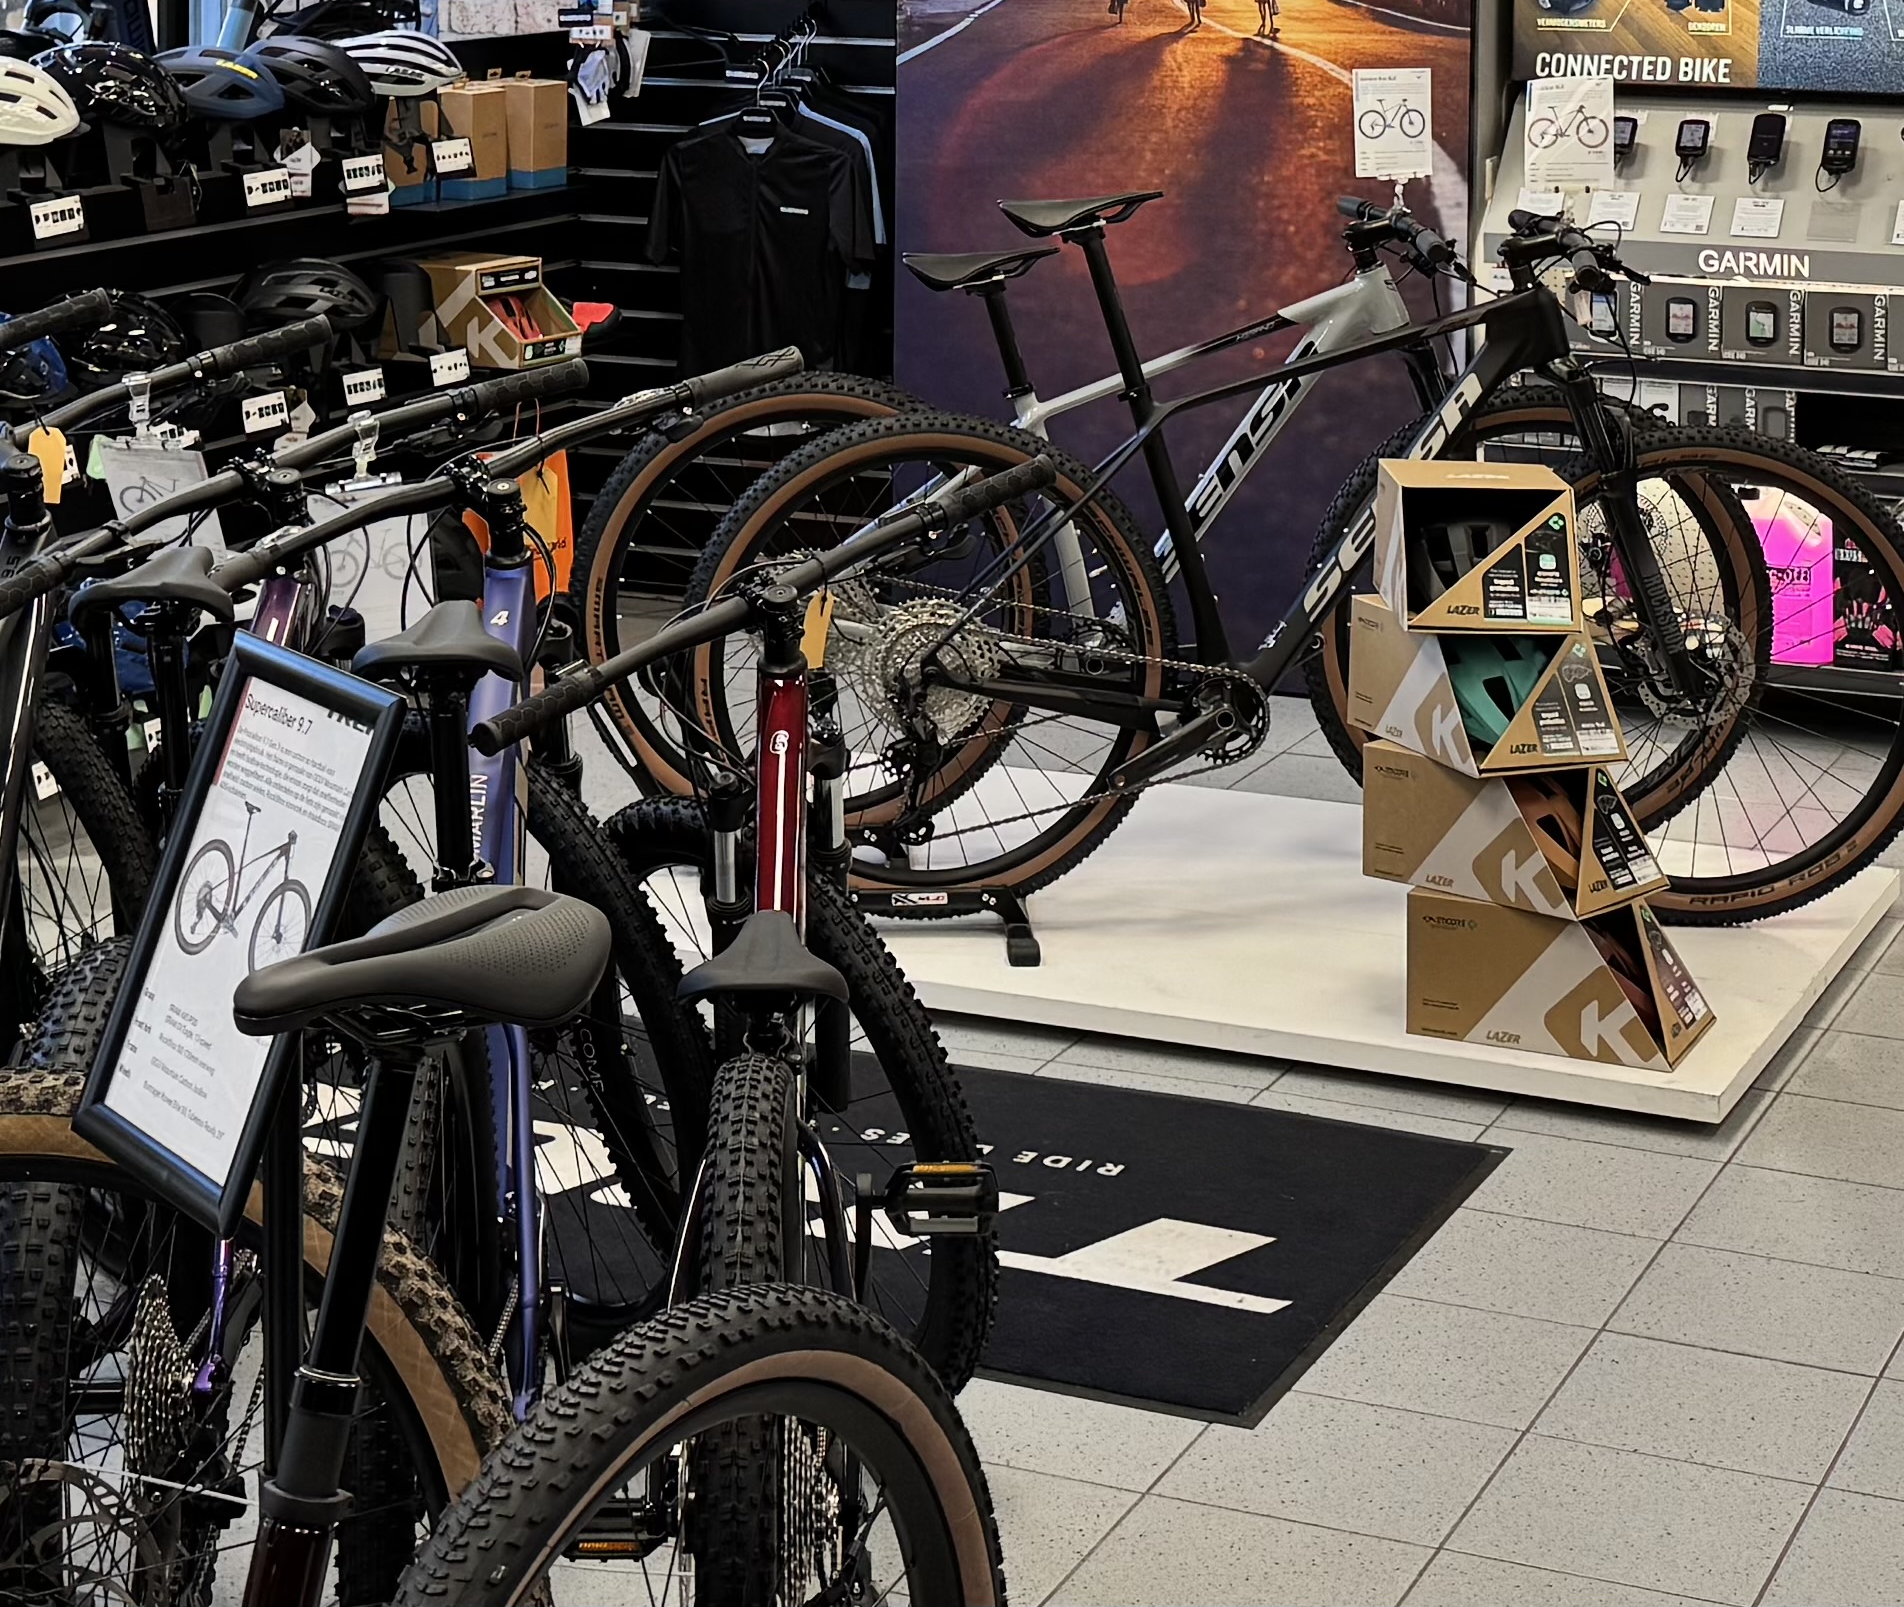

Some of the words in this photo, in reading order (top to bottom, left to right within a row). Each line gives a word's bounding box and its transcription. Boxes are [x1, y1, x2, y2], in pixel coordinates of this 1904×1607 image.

[1534, 52, 1673, 83] CONNECTED
[1678, 57, 1733, 84] BIKE
[1698, 249, 1810, 278] GARMIN
[1629, 281, 1642, 346] GARMIN
[1707, 285, 1720, 353] GARMIN
[1788, 289, 1802, 357] GARMIN
[1872, 293, 1886, 363] GARMIN
[1705, 384, 1718, 426] GARM
[1744, 386, 1757, 430] GARM
[490, 610, 509, 628] 4
[1446, 604, 1480, 616] LAZER
[245, 693, 298, 729] Supercaliber
[297, 715, 314, 736] 9.7
[1510, 743, 1538, 755] LAZER
[470, 773, 488, 856] MARLIN
[1425, 874, 1454, 888] LAZER
[1587, 880, 1609, 894] LAZER
[1688, 884, 1776, 908] RAPID
[1486, 1029, 1521, 1044] LAZER
[1012, 1149, 1126, 1178] RIDE
